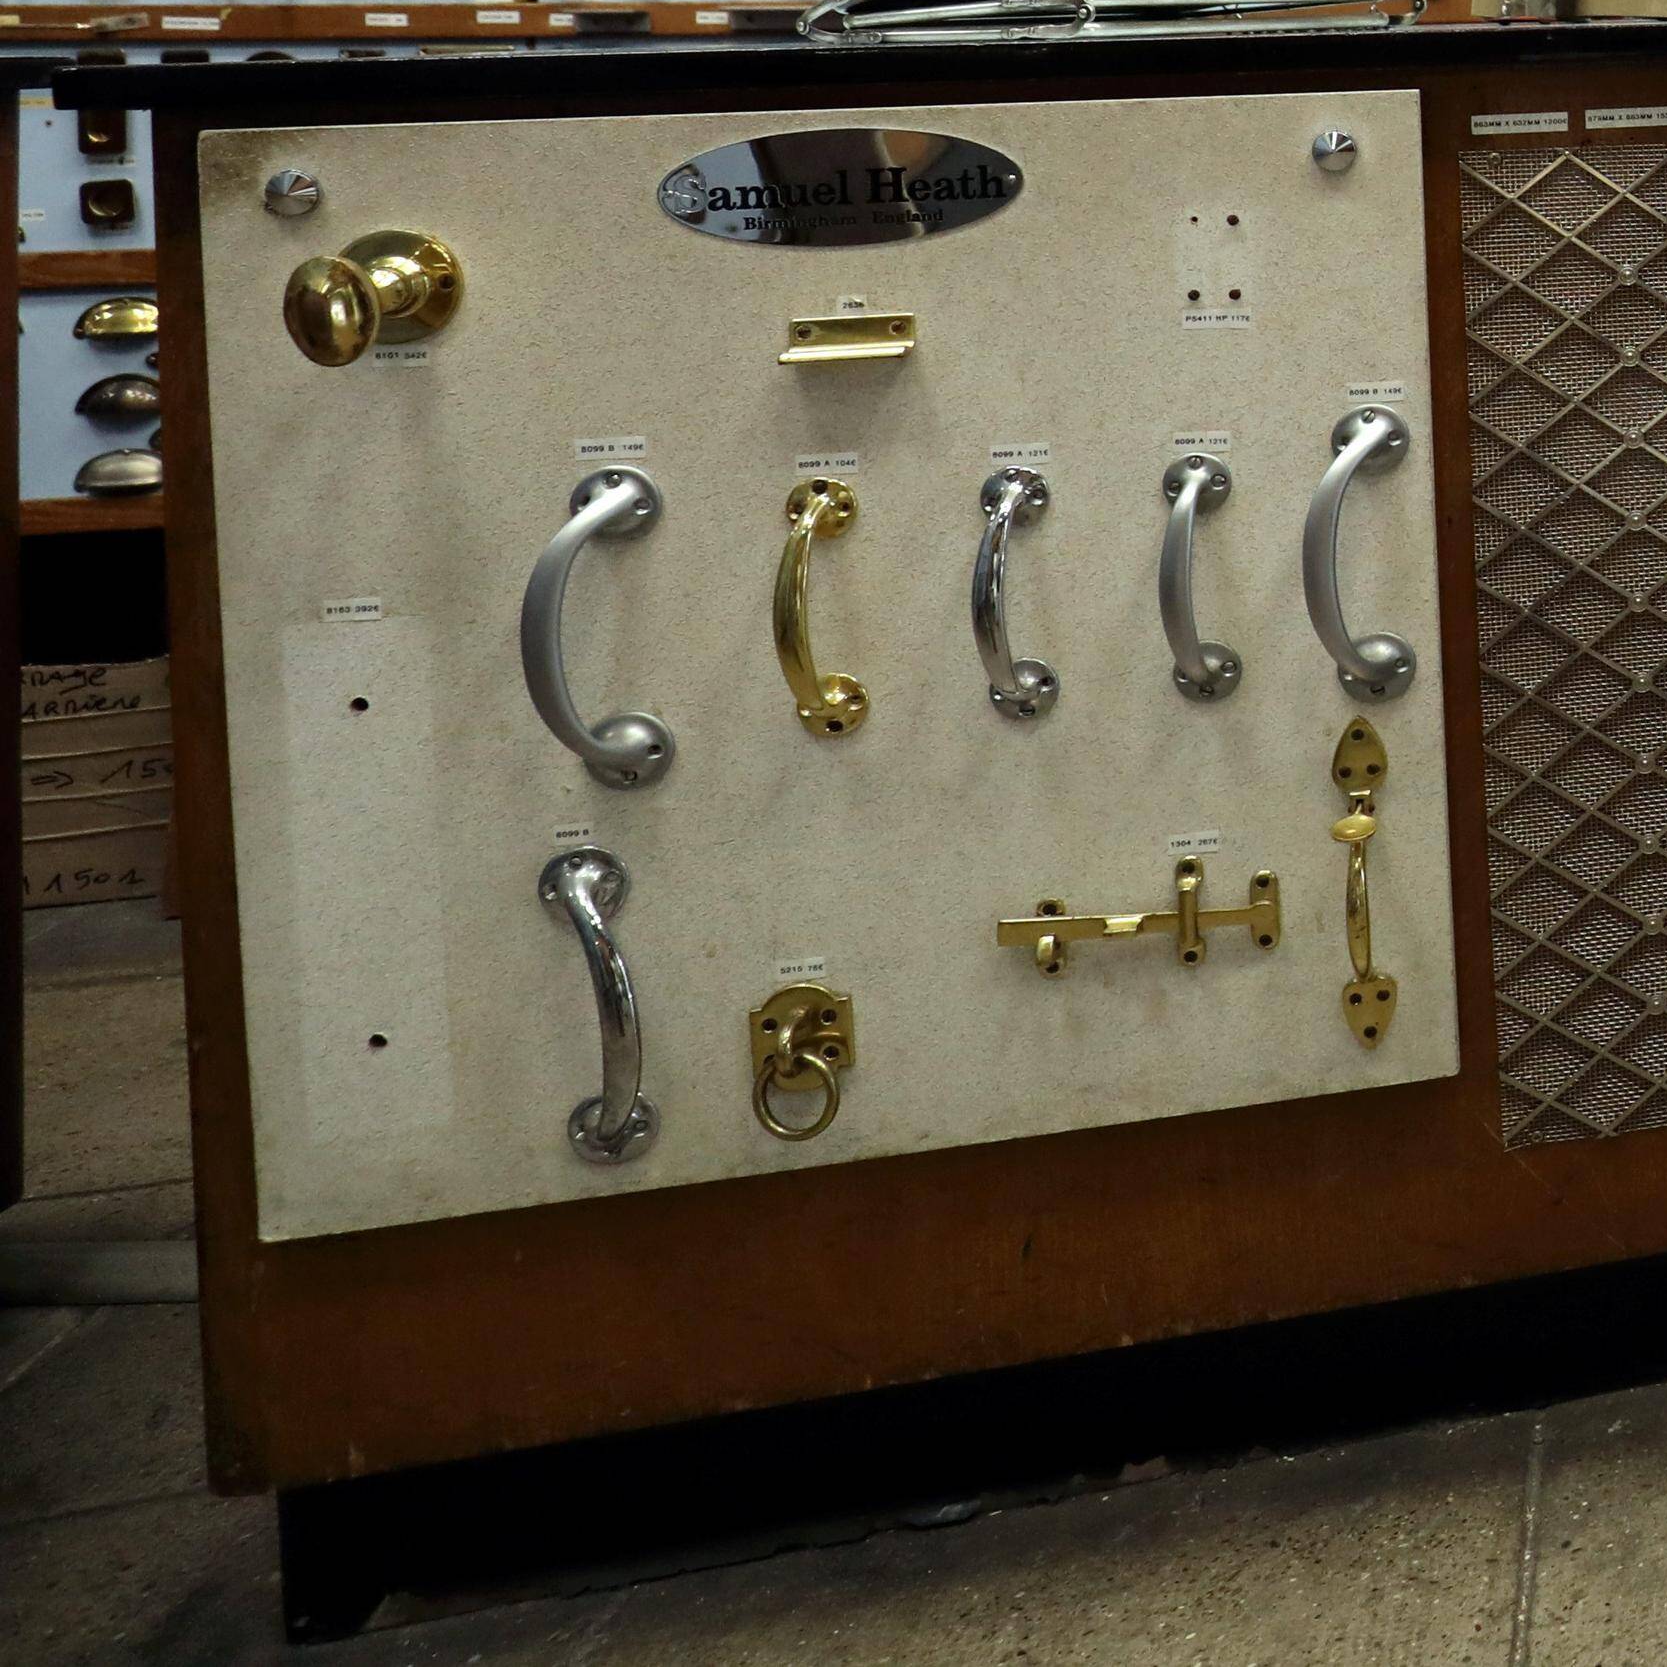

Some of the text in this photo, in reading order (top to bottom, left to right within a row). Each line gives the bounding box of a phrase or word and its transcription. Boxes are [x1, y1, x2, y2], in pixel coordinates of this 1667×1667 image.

[662, 165, 1006, 215] Samuel Heath
[743, 209, 944, 231] Birmingham England
